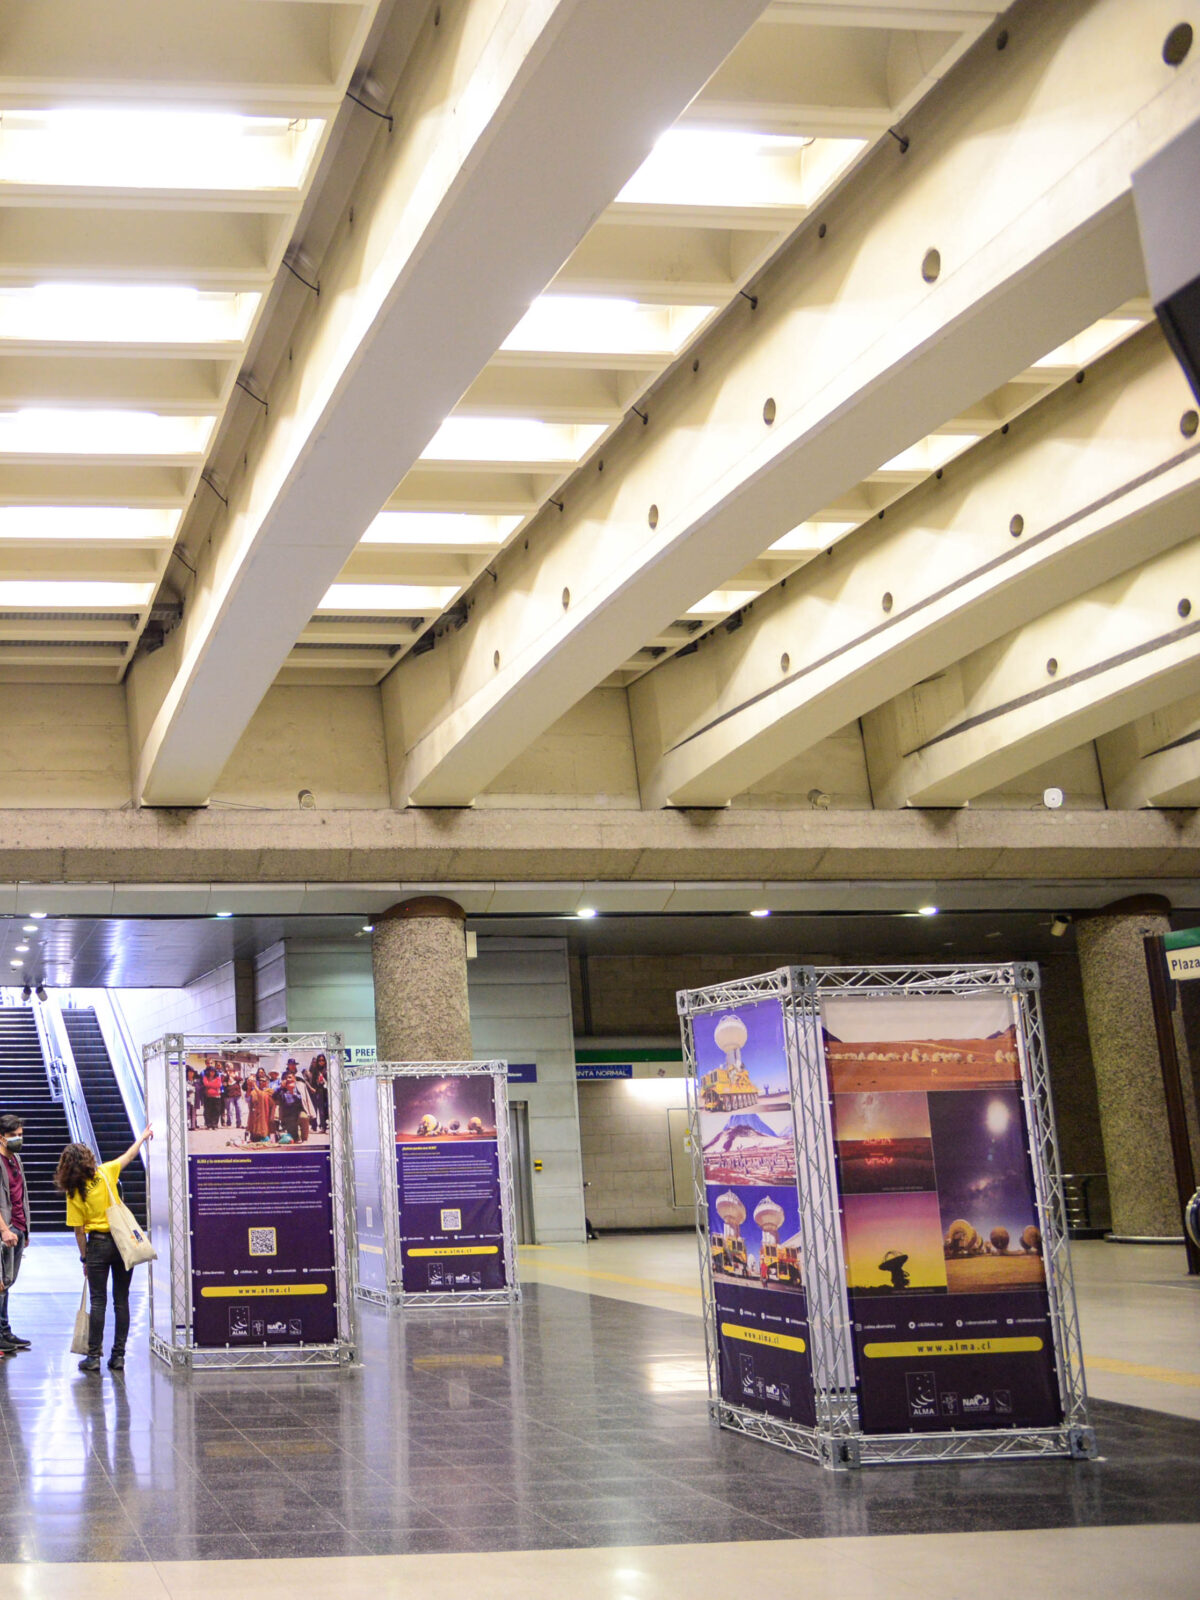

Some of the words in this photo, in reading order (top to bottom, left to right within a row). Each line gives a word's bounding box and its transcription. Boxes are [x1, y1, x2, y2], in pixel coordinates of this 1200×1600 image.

[1171, 958, 1200, 971] Plaza
[238, 1286, 291, 1294] www.alma.cl
[917, 1341, 991, 1353] www.alma.cl
[913, 1407, 935, 1416] ALMA
